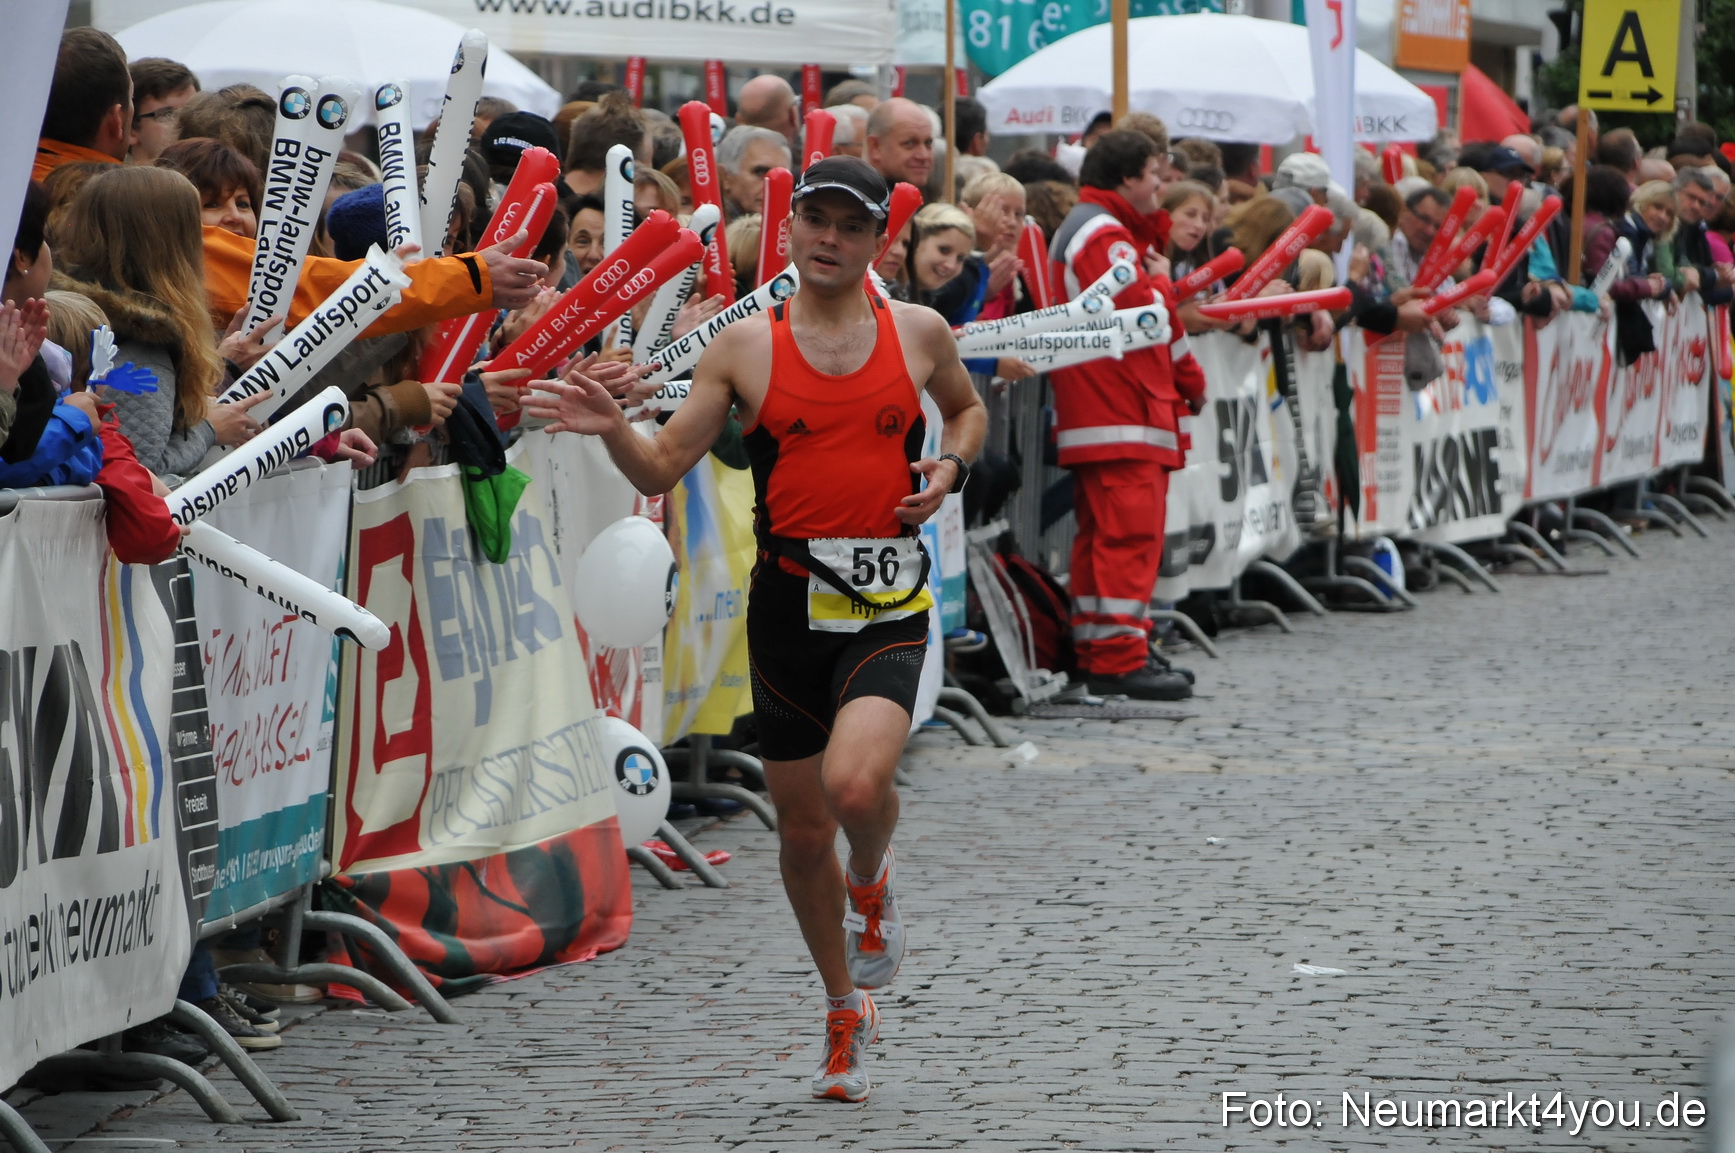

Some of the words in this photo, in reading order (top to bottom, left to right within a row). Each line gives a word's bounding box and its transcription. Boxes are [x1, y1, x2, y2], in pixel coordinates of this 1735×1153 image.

[477, 0, 795, 25] www.audibkk.de
[1601, 10, 1655, 78] A
[1004, 107, 1054, 125] Audi
[265, 138, 302, 212] BMW
[378, 122, 405, 180] BMW
[384, 185, 411, 250] Laufs
[274, 266, 391, 370] Laufsport
[515, 328, 553, 366] Audi
[550, 299, 586, 333] BKK
[256, 426, 311, 481] BMW
[813, 583, 820, 592] A
[851, 546, 900, 587] 56
